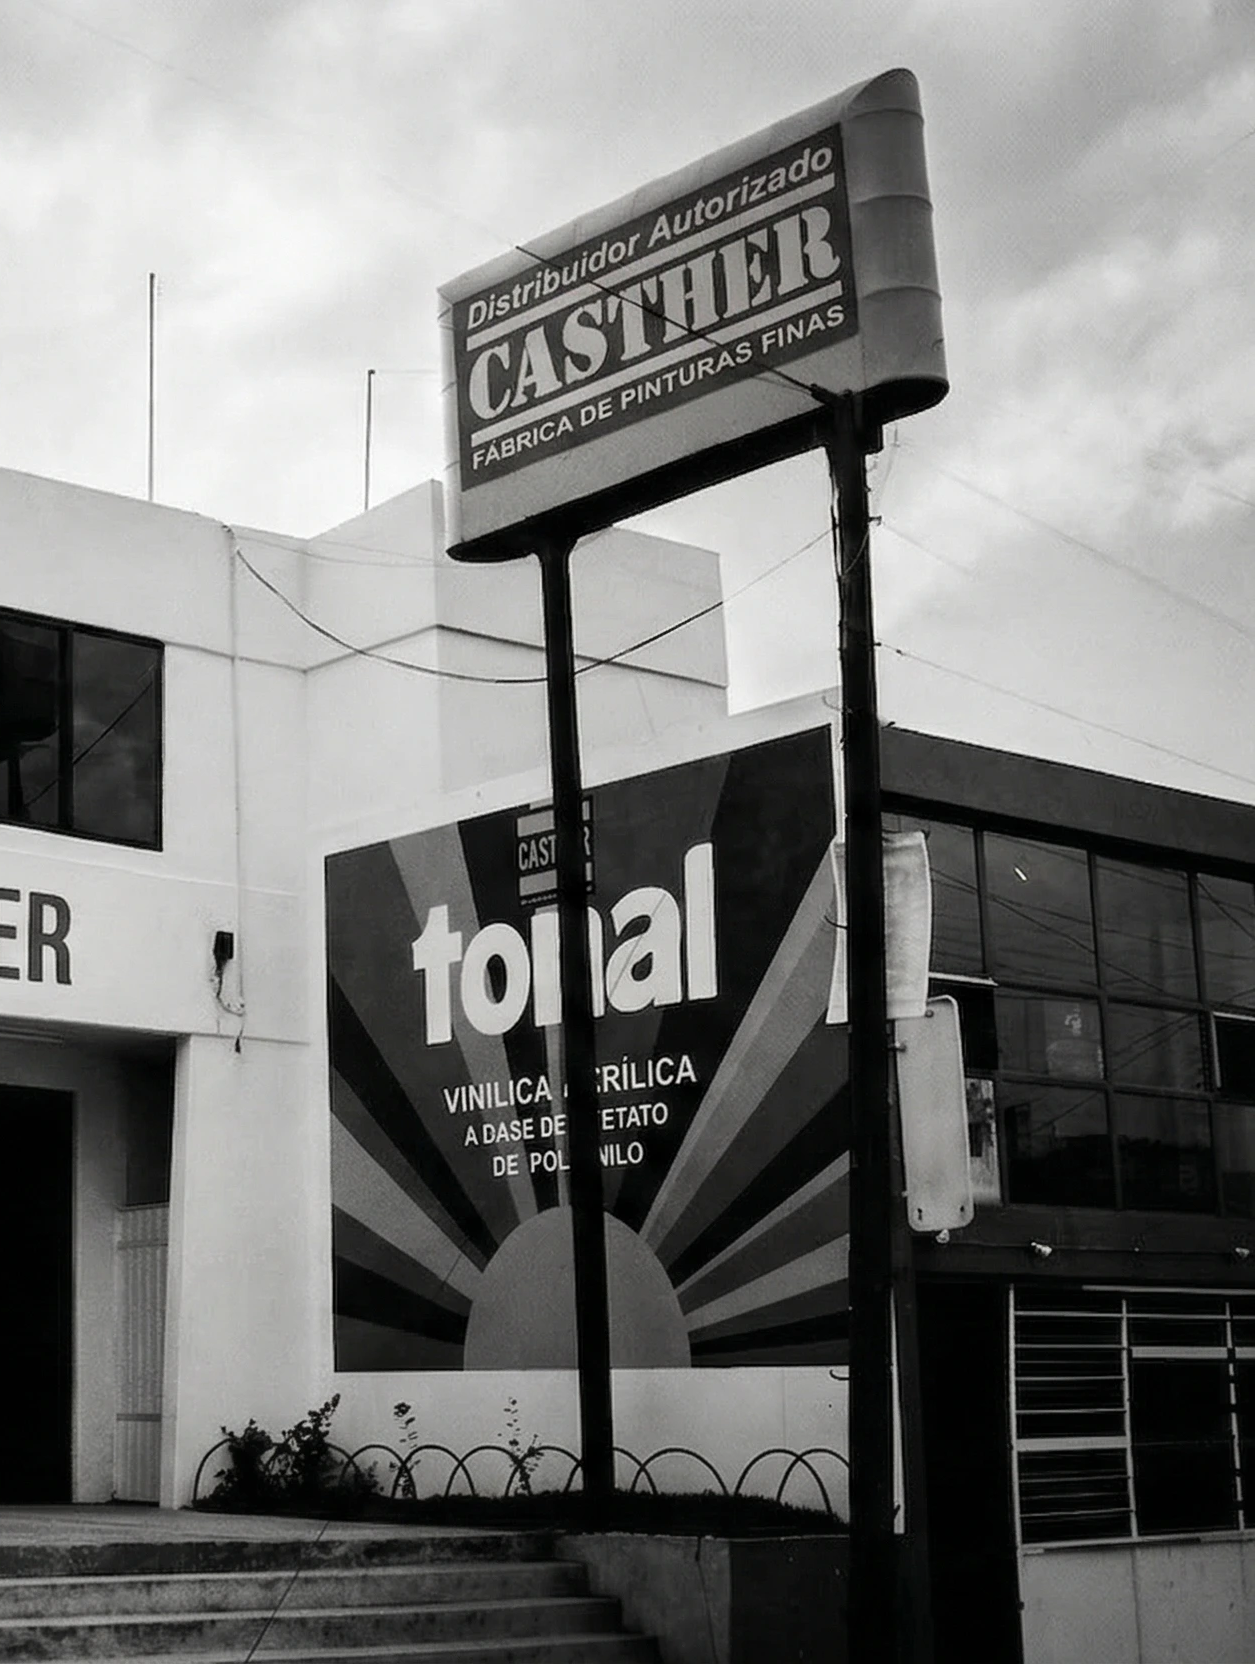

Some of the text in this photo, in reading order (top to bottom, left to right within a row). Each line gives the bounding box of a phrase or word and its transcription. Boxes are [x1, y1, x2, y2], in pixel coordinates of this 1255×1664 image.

[467, 147, 833, 331] Distribuidor Autorizado
[469, 206, 841, 420] CASTHER
[472, 305, 845, 471] FÁBRICA DE PINTURAS FINAS
[412, 841, 718, 1046] tonal
[443, 1055, 697, 1114] VINILICA RÍLICA
[464, 1125, 479, 1147] A
[540, 1114, 567, 1138] DE
[596, 1102, 669, 1131] ETATO
[493, 1153, 519, 1177] DE
